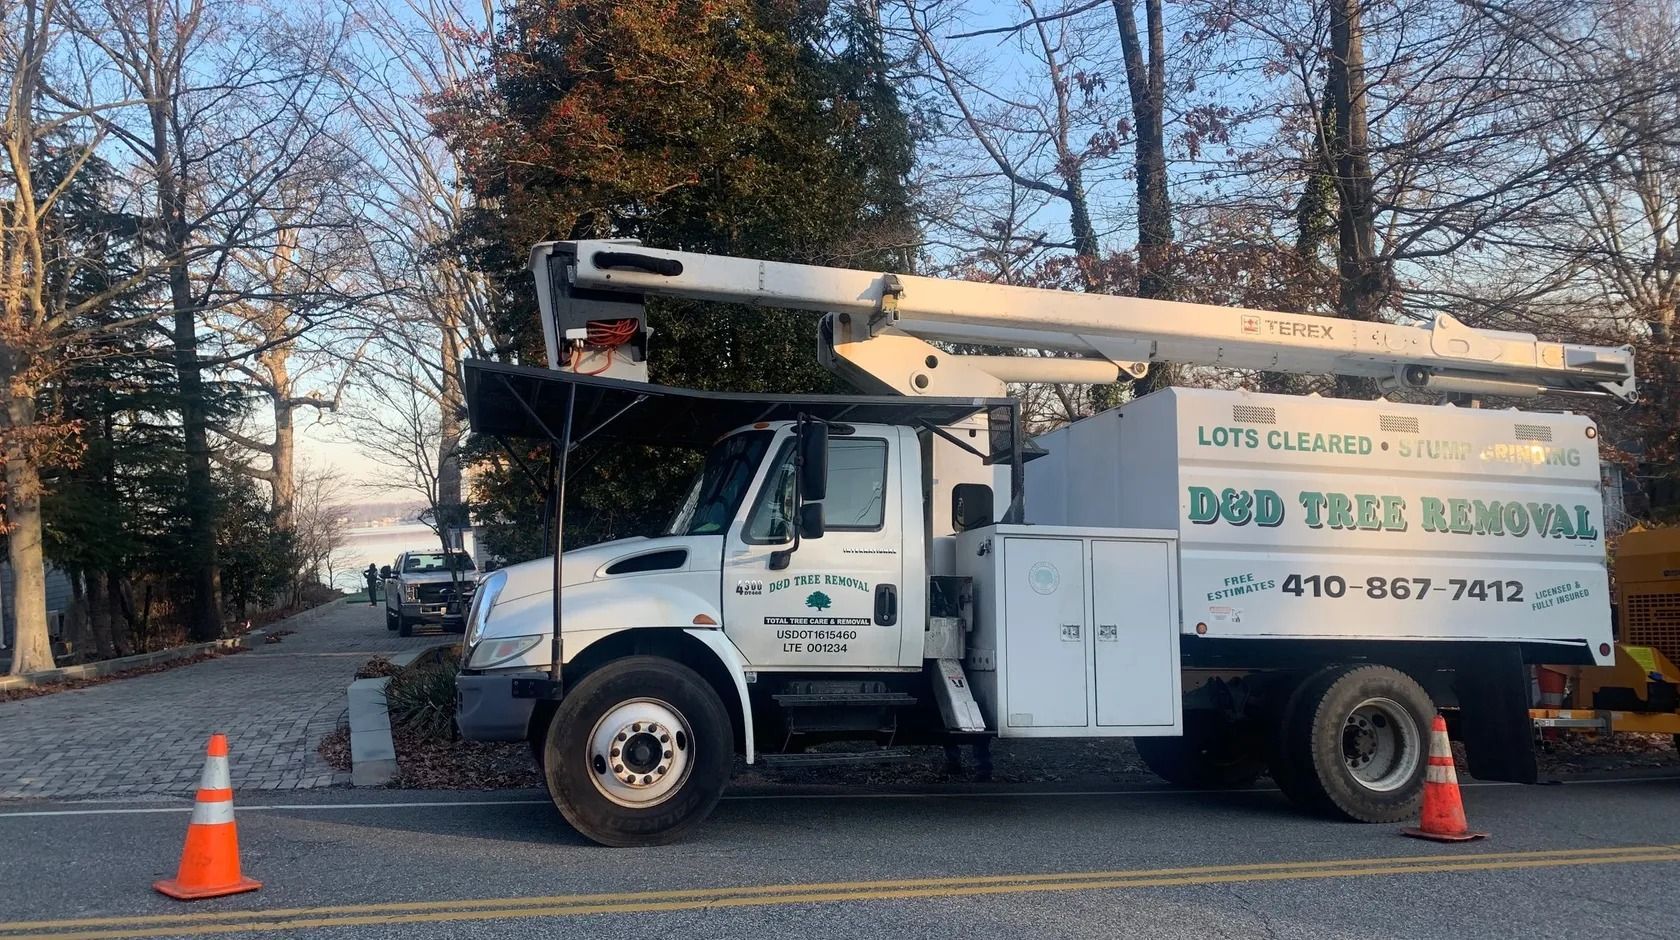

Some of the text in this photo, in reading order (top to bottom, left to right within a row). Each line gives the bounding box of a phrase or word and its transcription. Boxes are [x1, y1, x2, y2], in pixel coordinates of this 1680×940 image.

[1265, 319, 1334, 340] TEREX
[1198, 425, 1259, 449] LOTS
[1267, 430, 1373, 455] CLEARED
[1398, 438, 1473, 462] STUMP
[1187, 486, 1598, 541] D&D TREE REMOVAL
[769, 575, 870, 593] D&D TREE REMOVAL
[1206, 579, 1276, 601] ESTIMATES
[1224, 573, 1255, 587] FREE
[1282, 574, 1524, 603] 410-867-7412
[1535, 581, 1581, 600] LICENSED &
[1532, 589, 1590, 611] FULLY INSURED
[777, 630, 857, 640] USDOT1615460
[783, 643, 848, 653] LTE 001234
